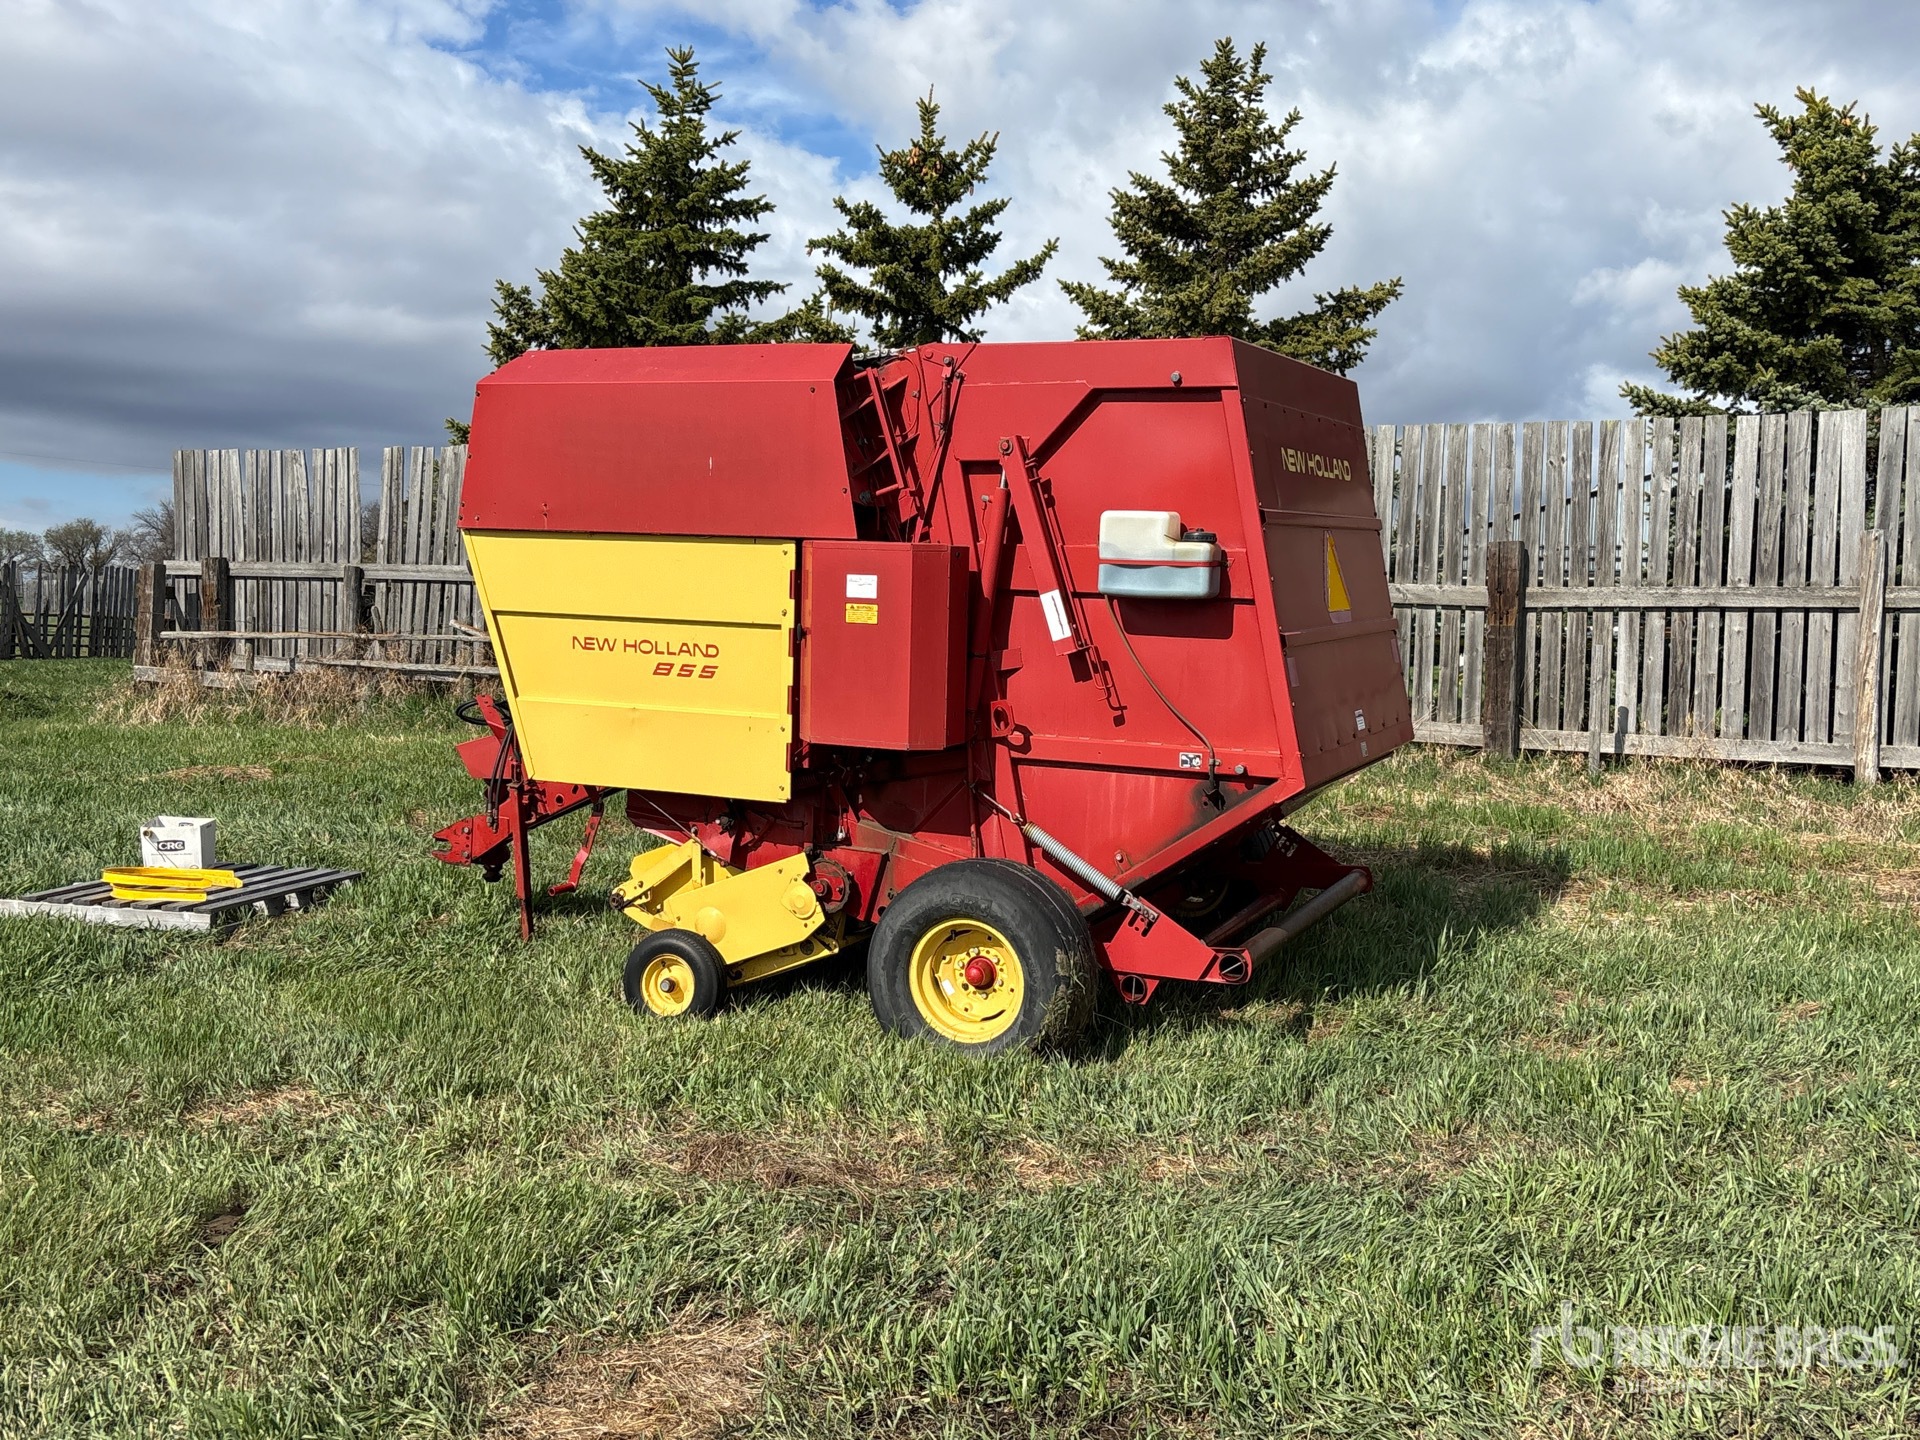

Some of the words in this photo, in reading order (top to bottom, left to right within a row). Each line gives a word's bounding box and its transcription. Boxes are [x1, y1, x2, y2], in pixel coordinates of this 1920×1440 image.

[1281, 447, 1306, 474] NEW
[1306, 452, 1351, 482] HOLLAND
[572, 636, 617, 652] NEW
[623, 638, 720, 659] HOLLAND
[652, 662, 719, 679] 855
[158, 841, 184, 851] CRC
